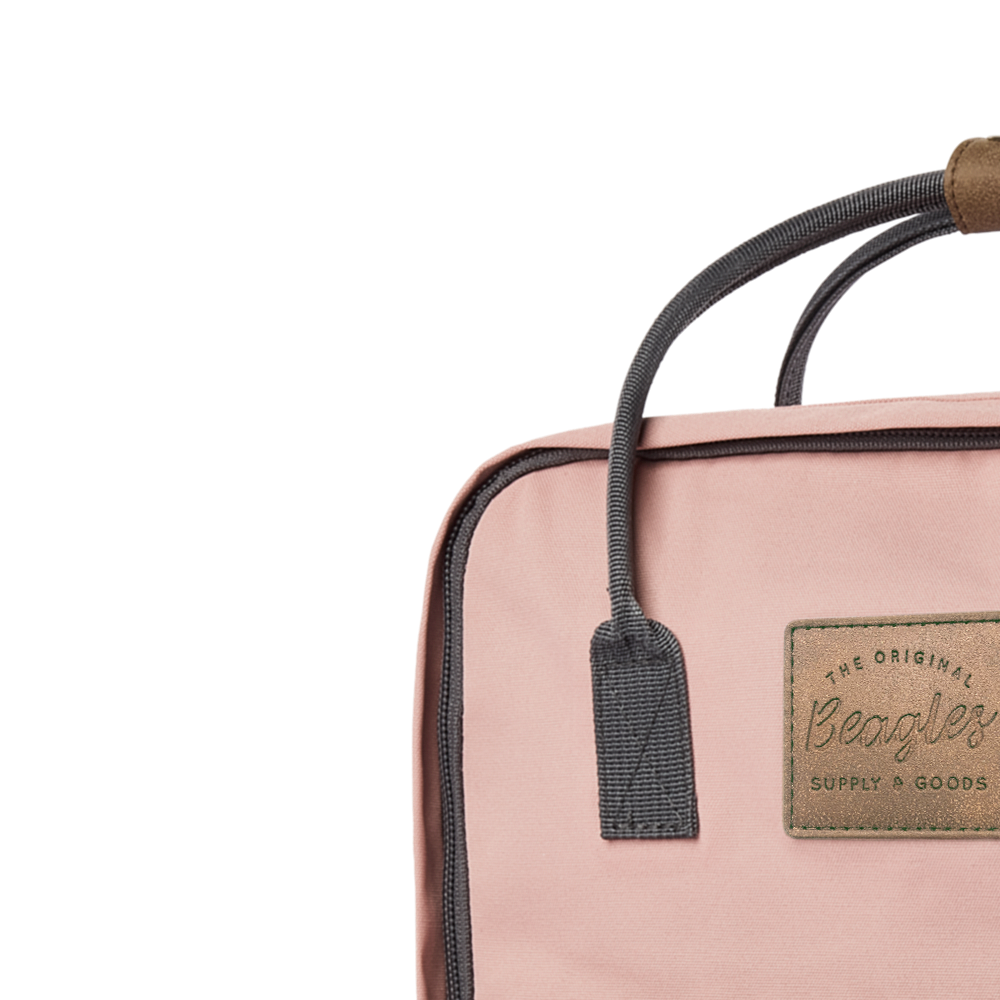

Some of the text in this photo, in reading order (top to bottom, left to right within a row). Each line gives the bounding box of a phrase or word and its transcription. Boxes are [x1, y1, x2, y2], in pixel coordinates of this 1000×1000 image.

[825, 650, 972, 688] THE ORIGINAL
[805, 692, 998, 762] Beagles
[810, 777, 881, 791] SUPPLY
[915, 776, 988, 791] GOODS
